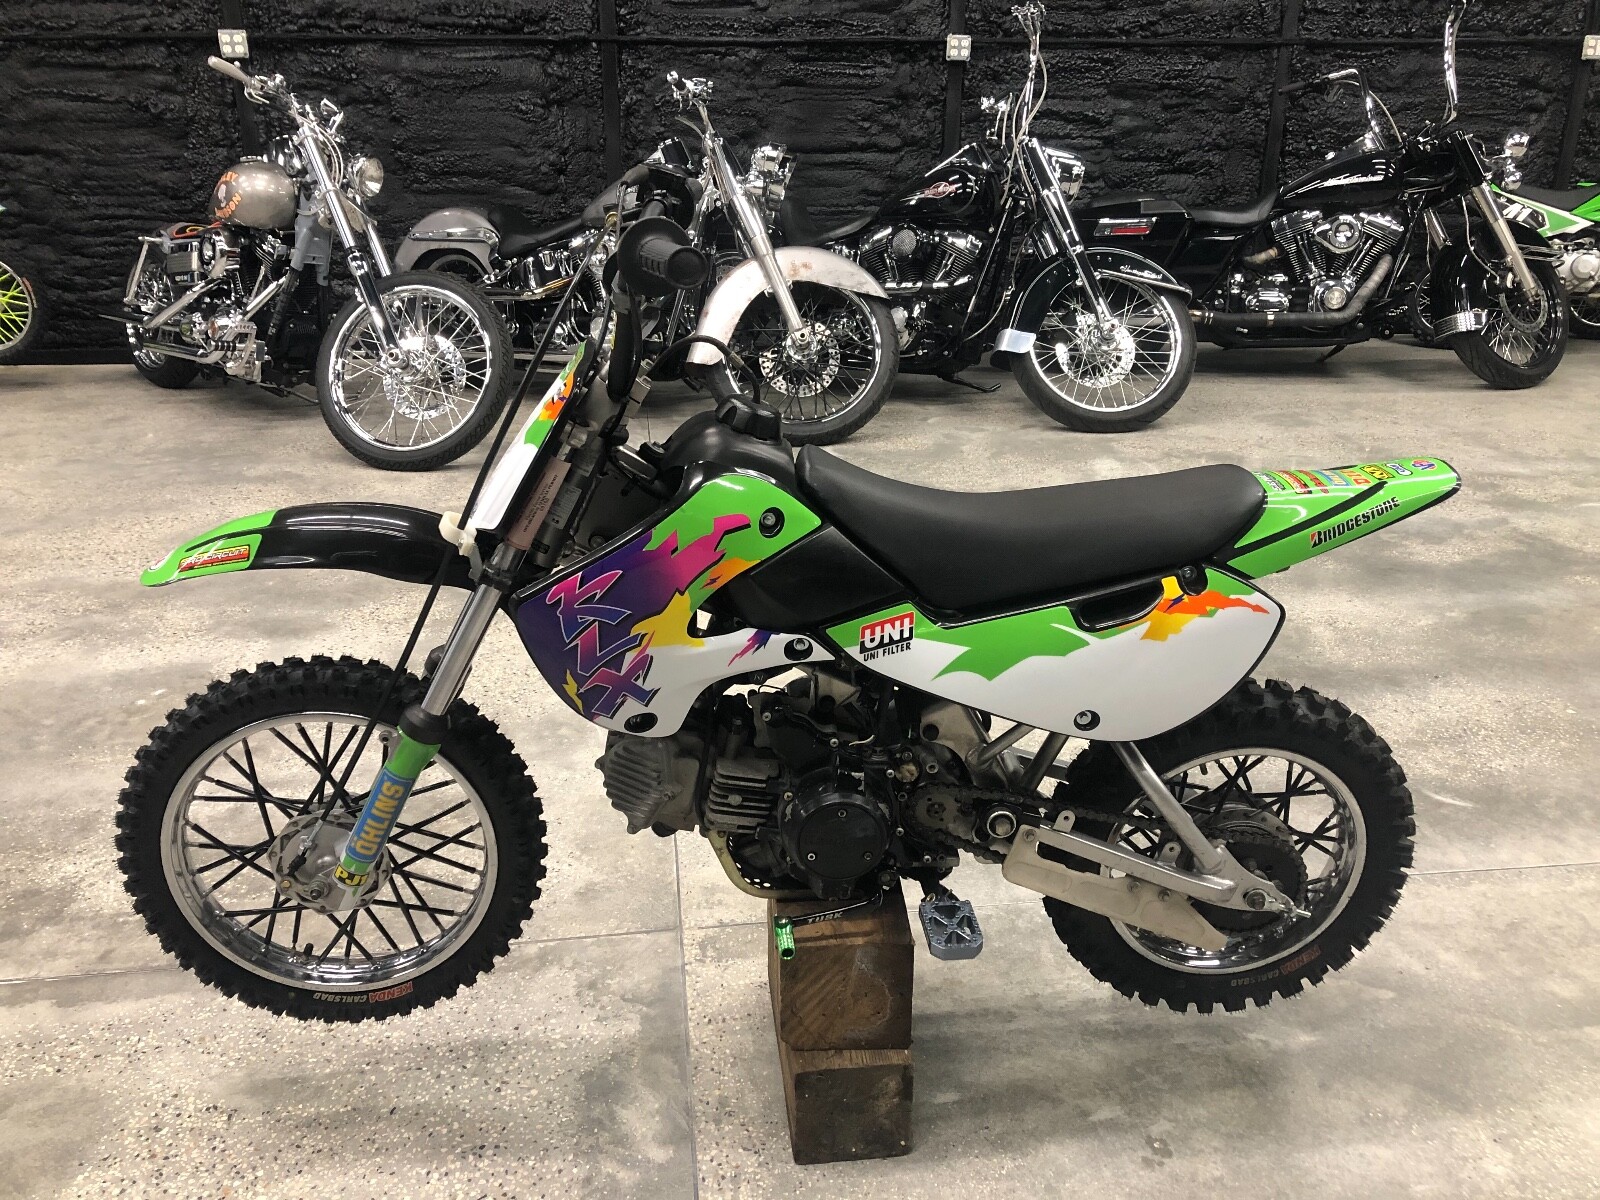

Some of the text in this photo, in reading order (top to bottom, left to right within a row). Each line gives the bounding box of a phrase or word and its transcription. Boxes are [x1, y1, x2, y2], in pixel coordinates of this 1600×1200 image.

[1310, 496, 1400, 548] BRIDGESTONE
[545, 569, 660, 718] KLX
[864, 617, 910, 649] UNI
[863, 641, 912, 662] UNI FILTER
[351, 780, 405, 856] ÖHLINS
[807, 912, 843, 924] TUSK
[313, 981, 413, 1003] KENDA CARLSBAD
